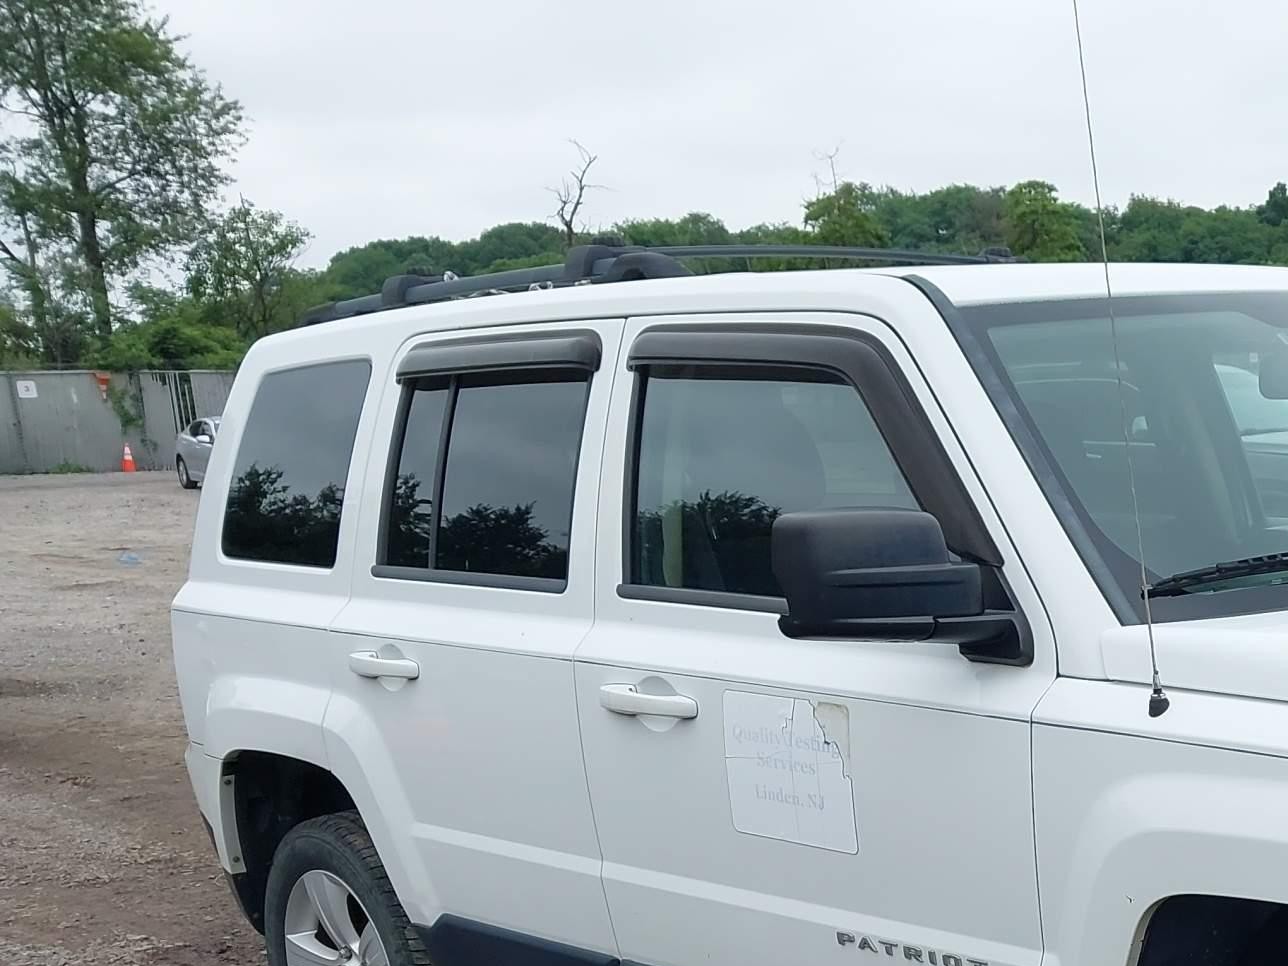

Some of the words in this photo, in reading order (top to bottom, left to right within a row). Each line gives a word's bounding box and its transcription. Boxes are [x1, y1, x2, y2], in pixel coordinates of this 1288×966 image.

[731, 724, 781, 746] Quality
[756, 751, 816, 775] Services
[807, 794, 825, 811] NJ
